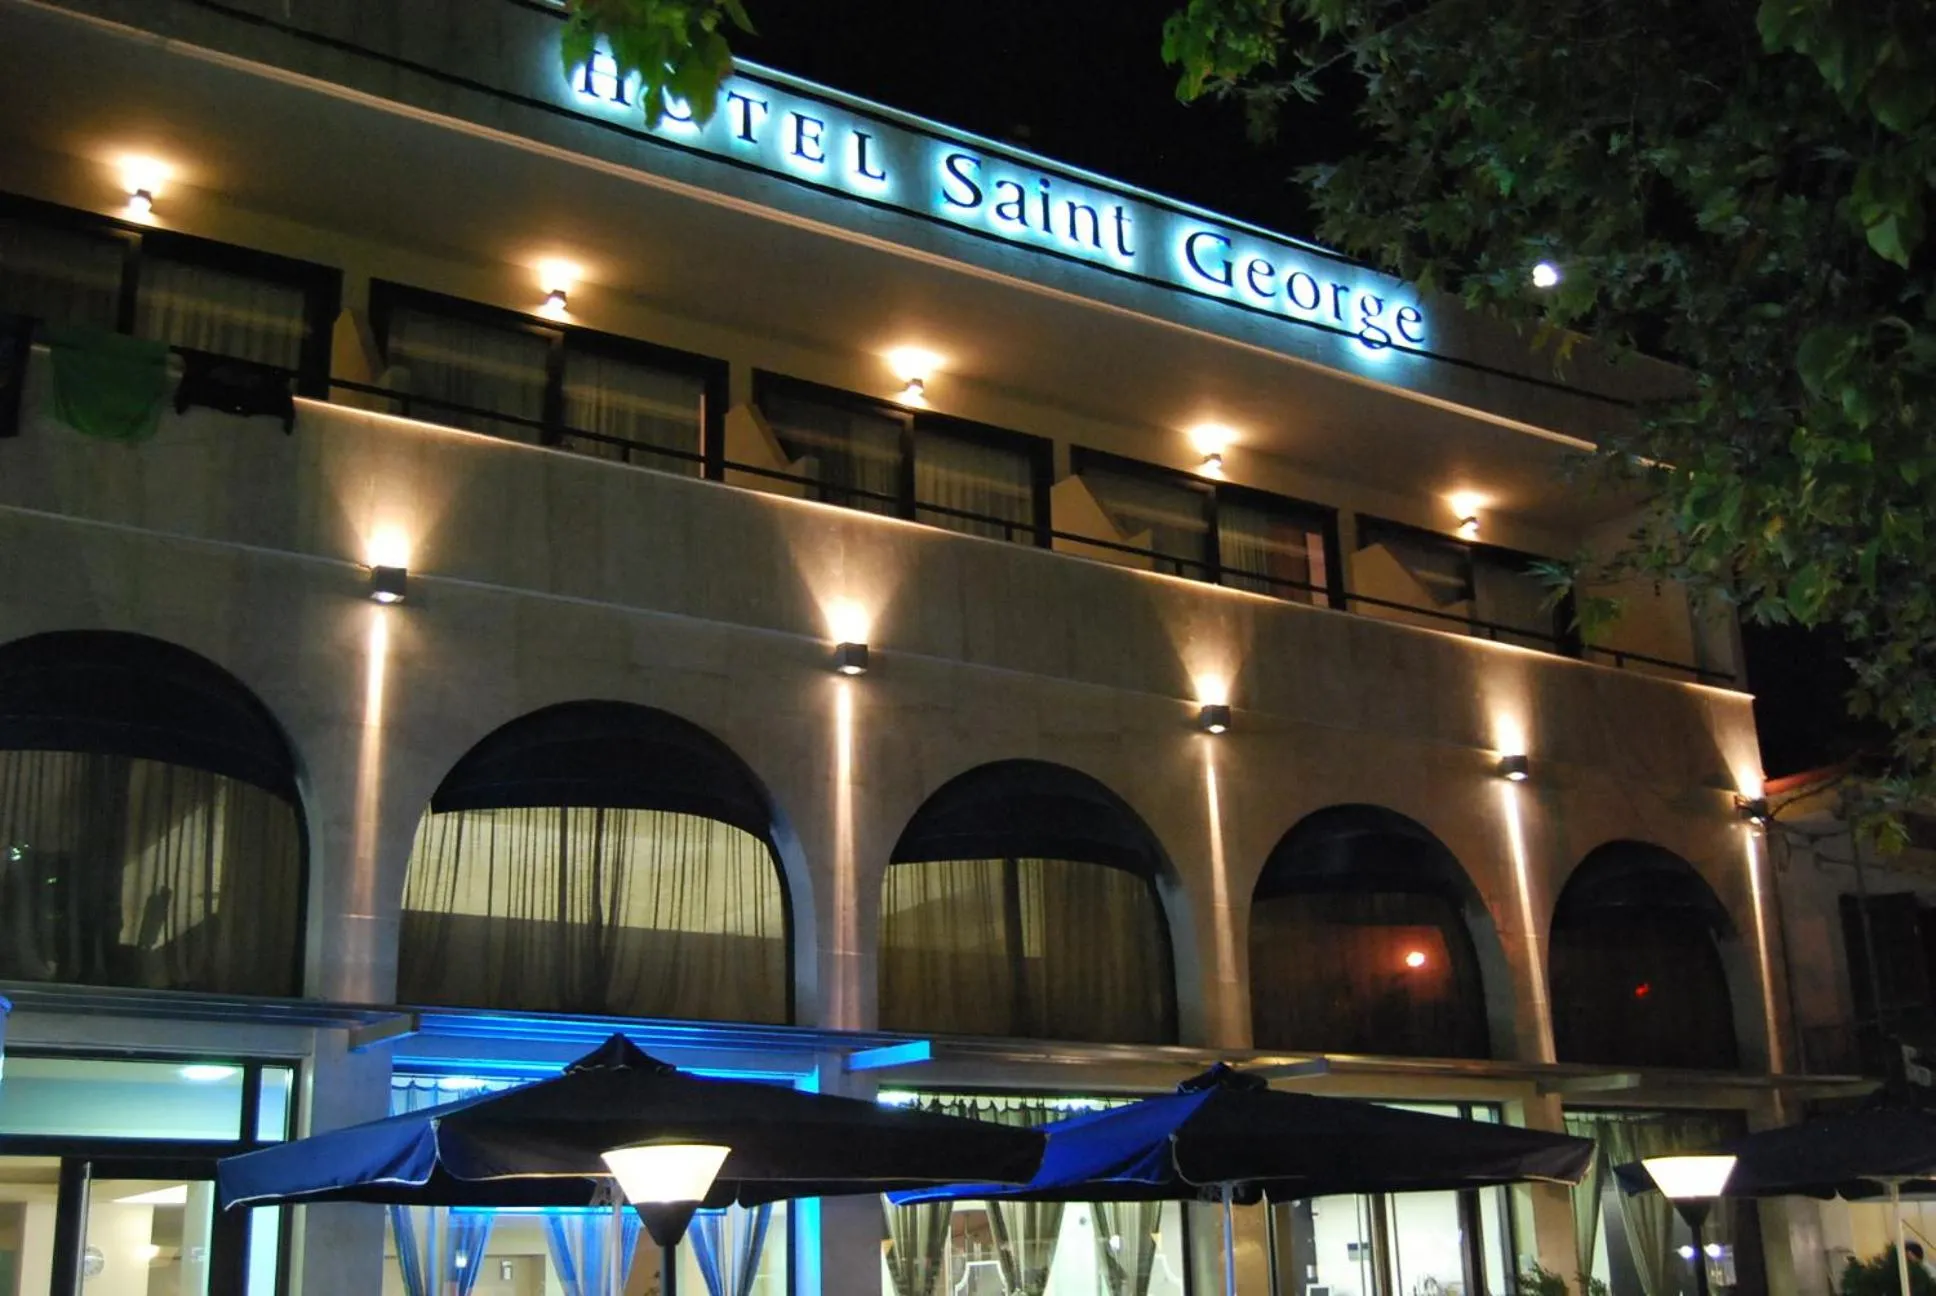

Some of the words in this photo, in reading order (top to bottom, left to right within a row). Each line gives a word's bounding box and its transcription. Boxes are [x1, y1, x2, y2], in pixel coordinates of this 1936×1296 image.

[577, 49, 888, 182] HTEL
[941, 153, 1136, 257] Saint
[1184, 230, 1426, 350] George
